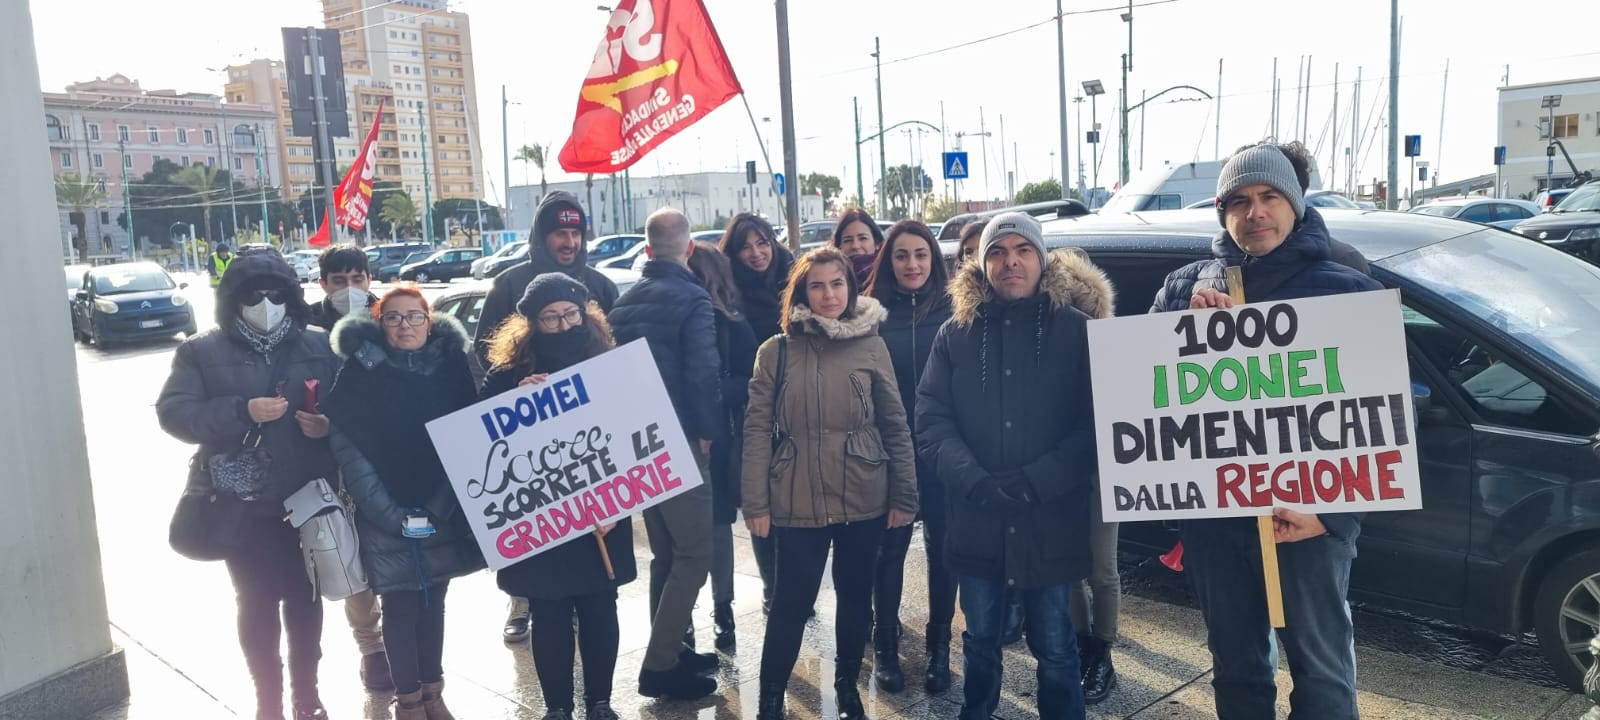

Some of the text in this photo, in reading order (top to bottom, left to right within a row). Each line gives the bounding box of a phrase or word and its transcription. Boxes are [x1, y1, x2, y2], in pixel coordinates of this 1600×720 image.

[1174, 303, 1298, 357] 1000
[481, 373, 591, 442] IDONEI
[1153, 347, 1345, 408] IDONEI
[1112, 393, 1409, 464] DIMENTICATI
[483, 422, 665, 530] SCORRETE LE
[496, 451, 682, 560] GRADUATORIE
[1114, 450, 1405, 511] DALLA REGIONE
